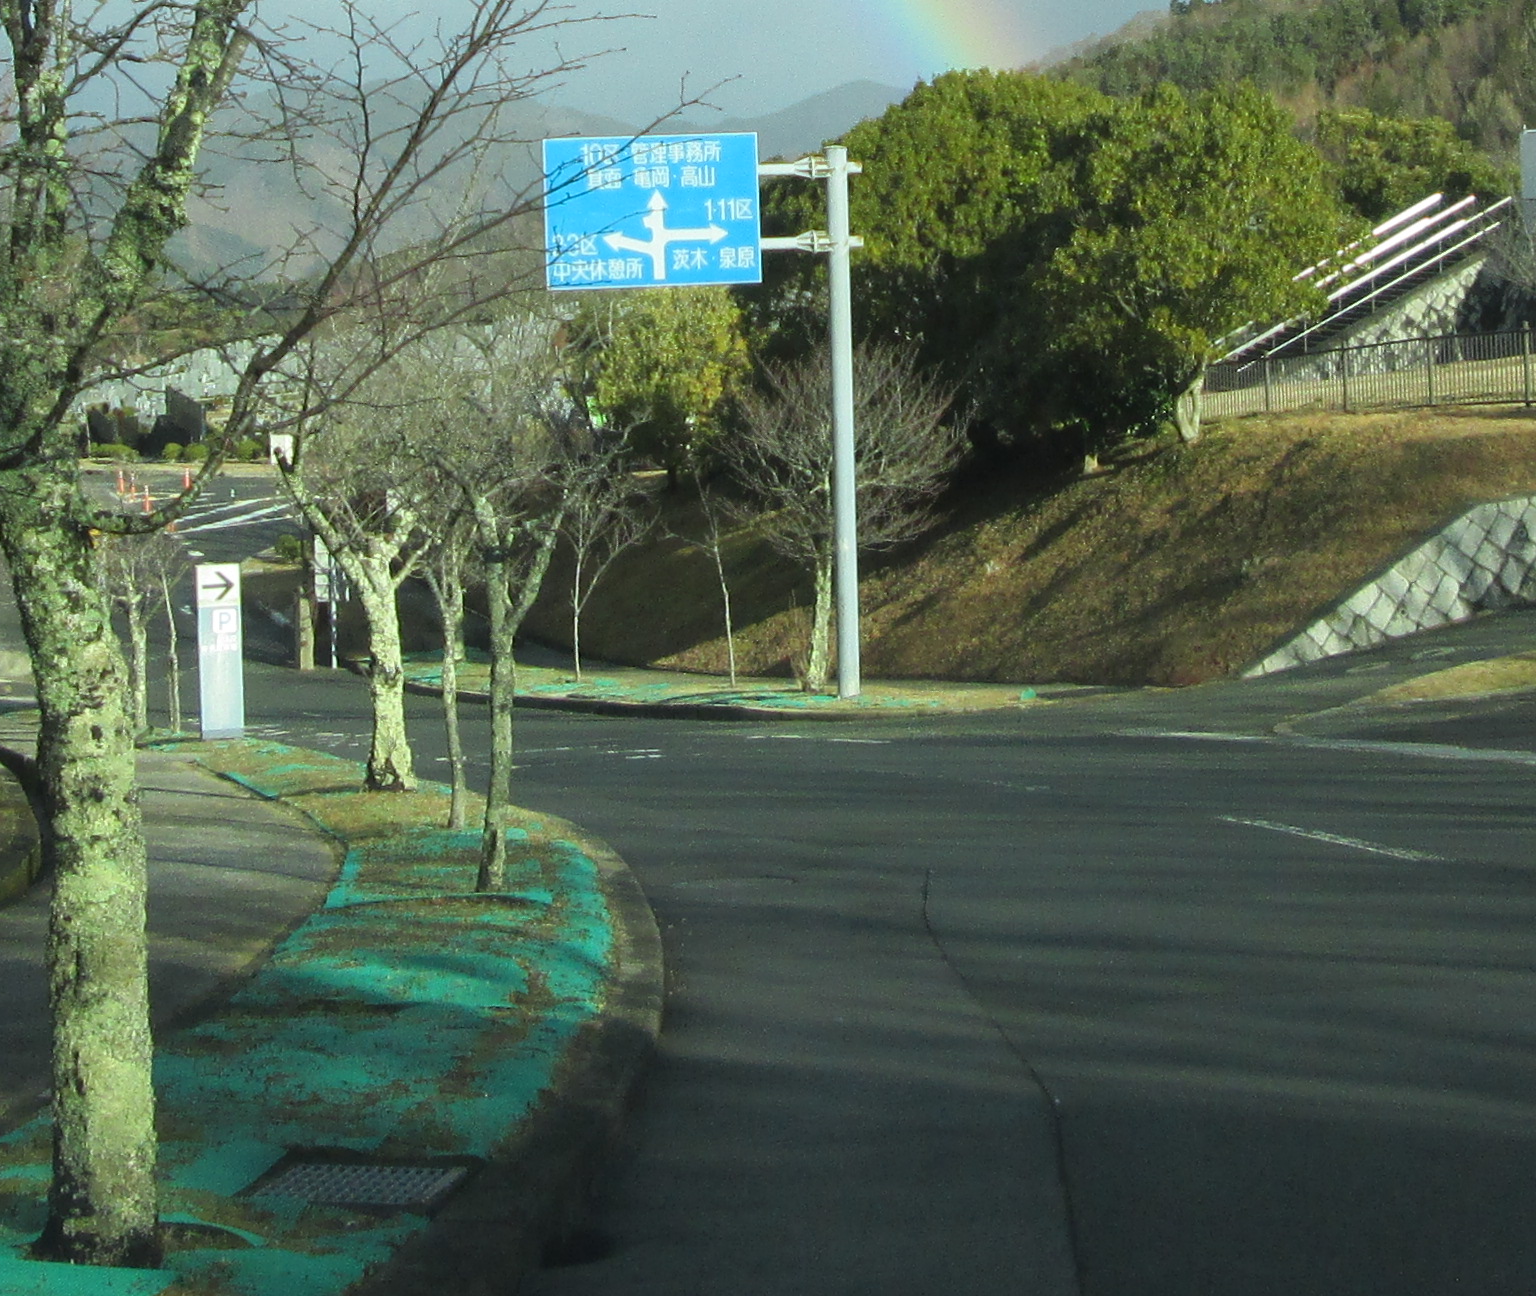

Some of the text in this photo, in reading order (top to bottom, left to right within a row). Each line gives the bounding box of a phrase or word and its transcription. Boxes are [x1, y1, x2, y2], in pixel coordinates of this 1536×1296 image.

[553, 257, 644, 282] 中央休憩所
[219, 611, 231, 631] P
